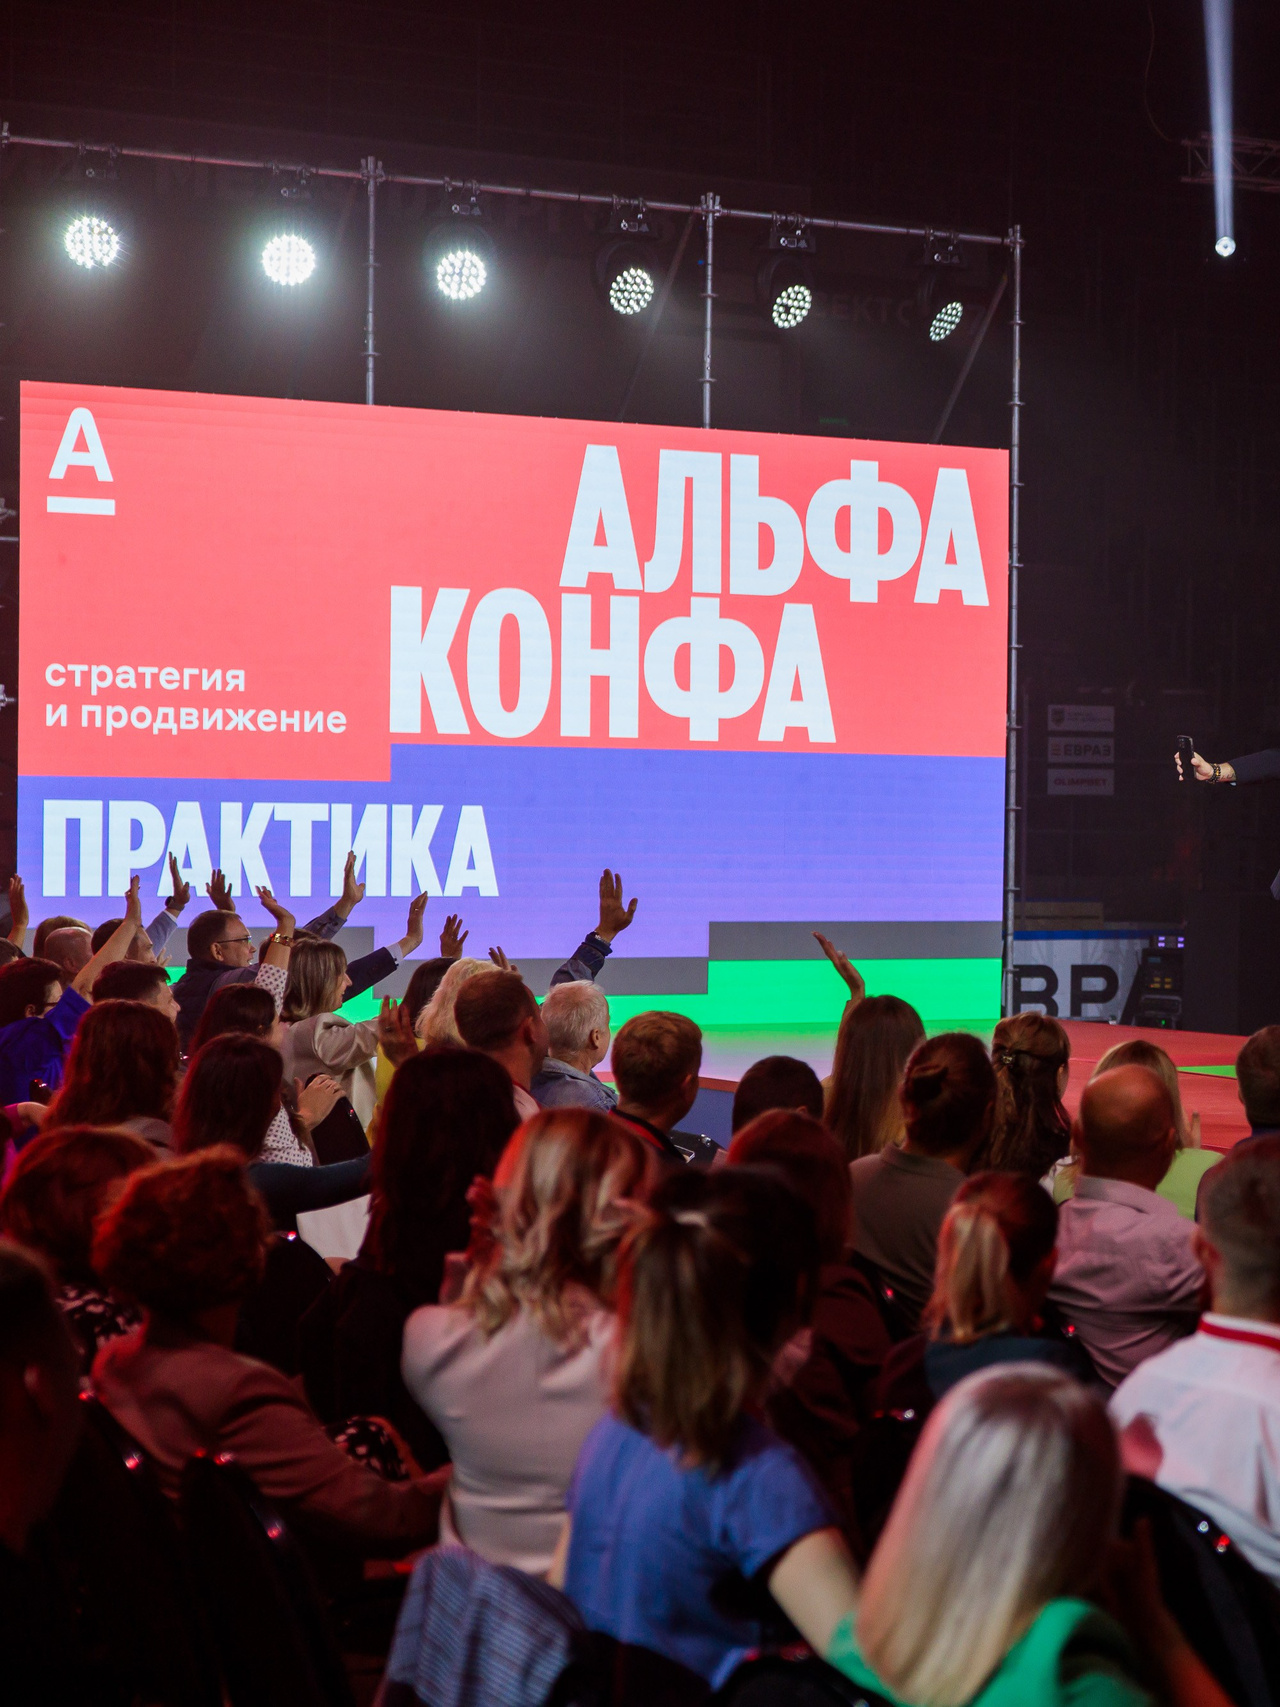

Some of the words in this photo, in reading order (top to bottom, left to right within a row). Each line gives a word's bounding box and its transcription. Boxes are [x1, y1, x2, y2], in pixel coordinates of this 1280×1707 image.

[559, 443, 989, 606] АЛЬФА
[45, 662, 245, 695] стратегия
[389, 585, 837, 743] КОНФА
[45, 703, 67, 727] и
[81, 703, 347, 735] продвижение
[42, 799, 500, 897] ПРАКТИКА
